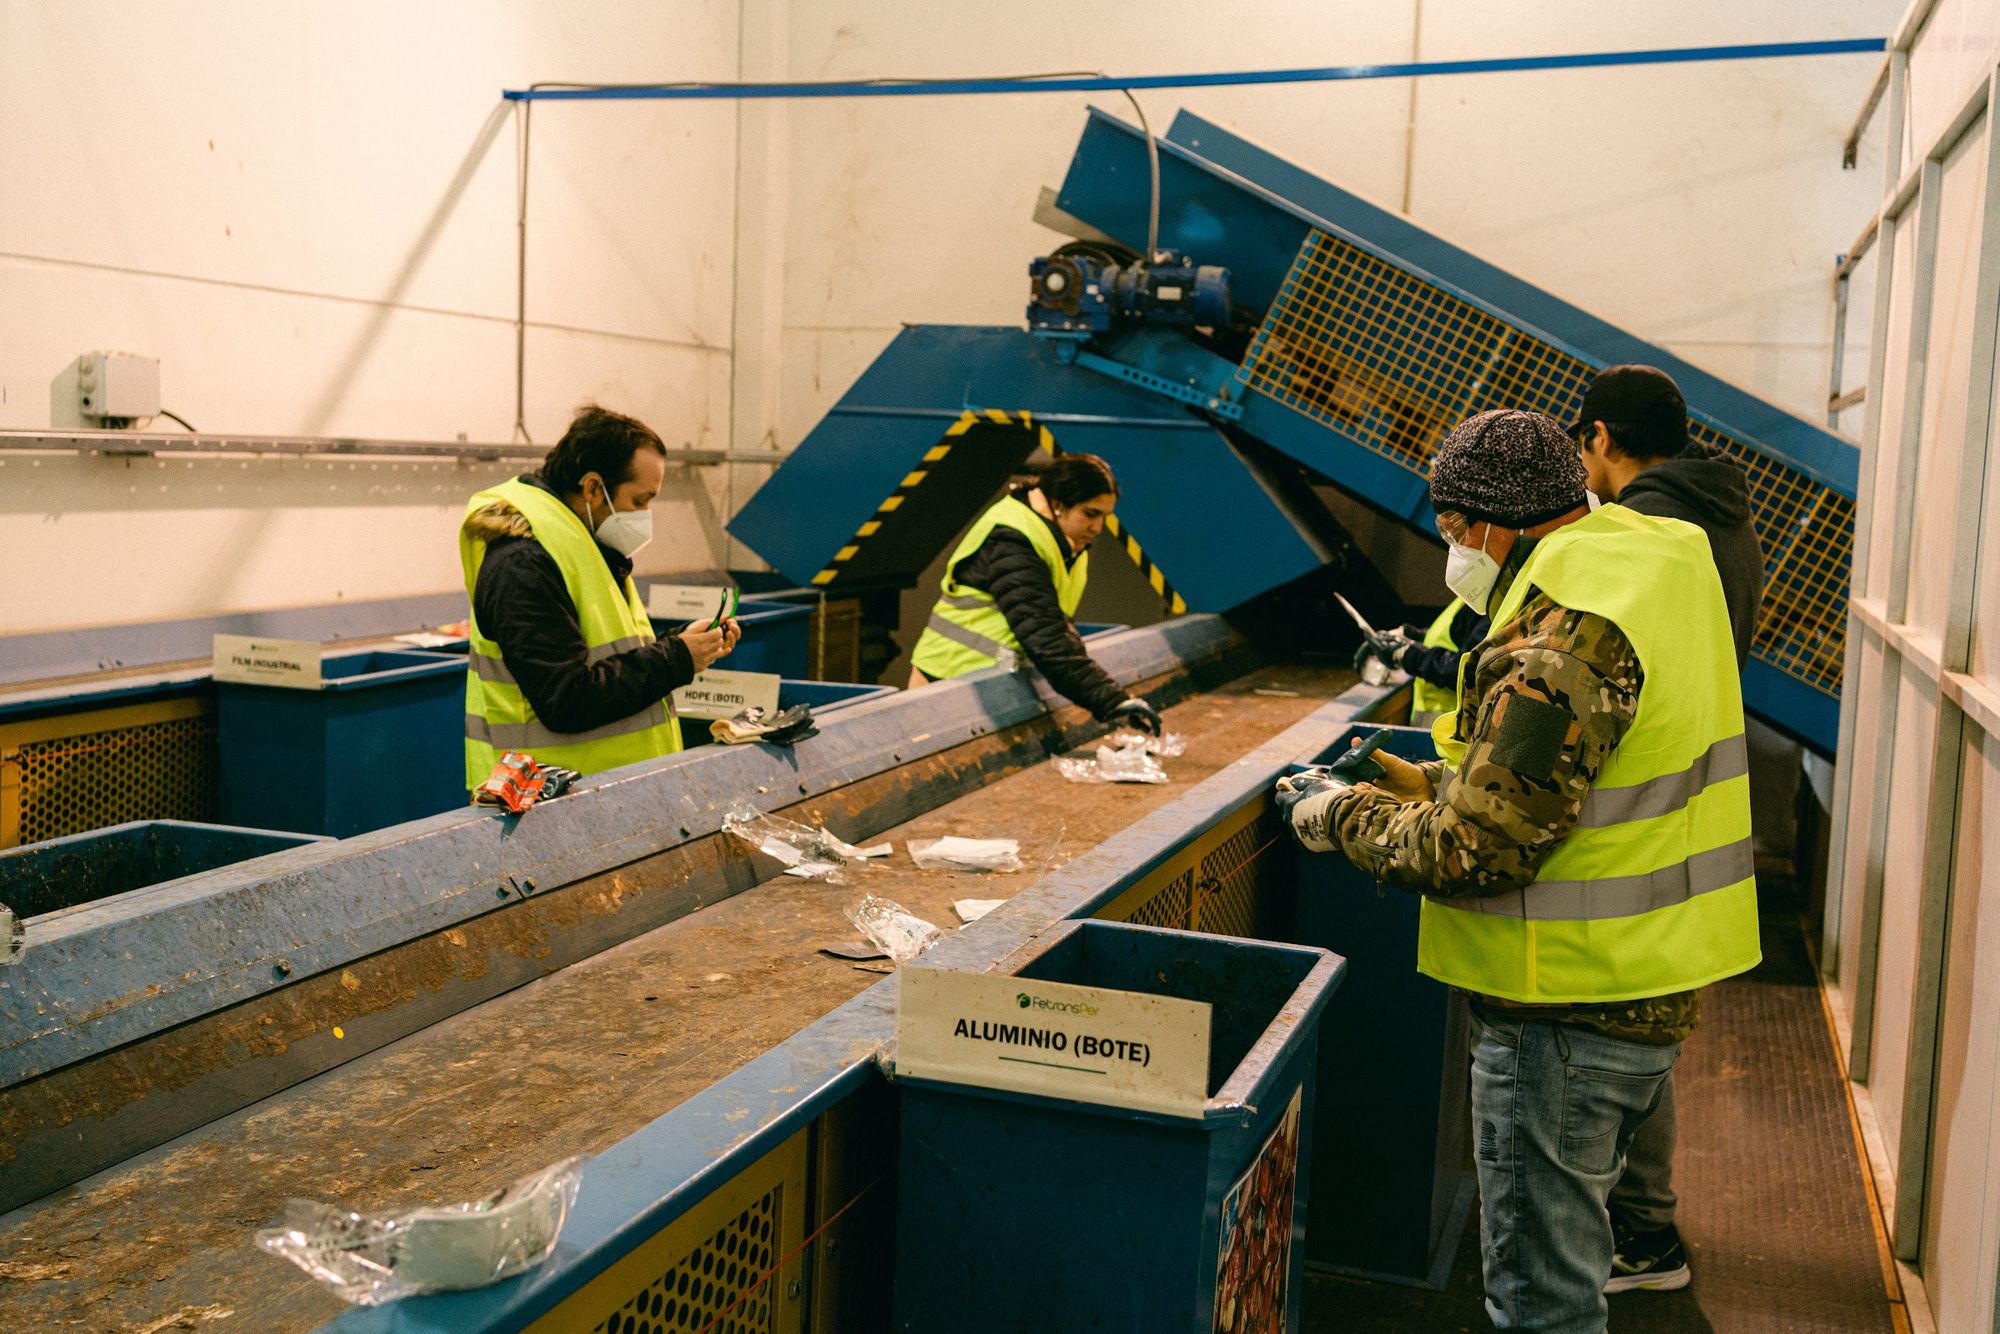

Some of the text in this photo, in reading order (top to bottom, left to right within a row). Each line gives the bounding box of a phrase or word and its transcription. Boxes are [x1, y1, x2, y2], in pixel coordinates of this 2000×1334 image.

[232, 656, 301, 671] FILM INDUSTRIAL
[685, 690, 744, 705] HDPE (BOTE)
[1032, 996, 1099, 1016] FetransPer
[954, 1018, 1151, 1067] ALUMINIO (BOTE)
